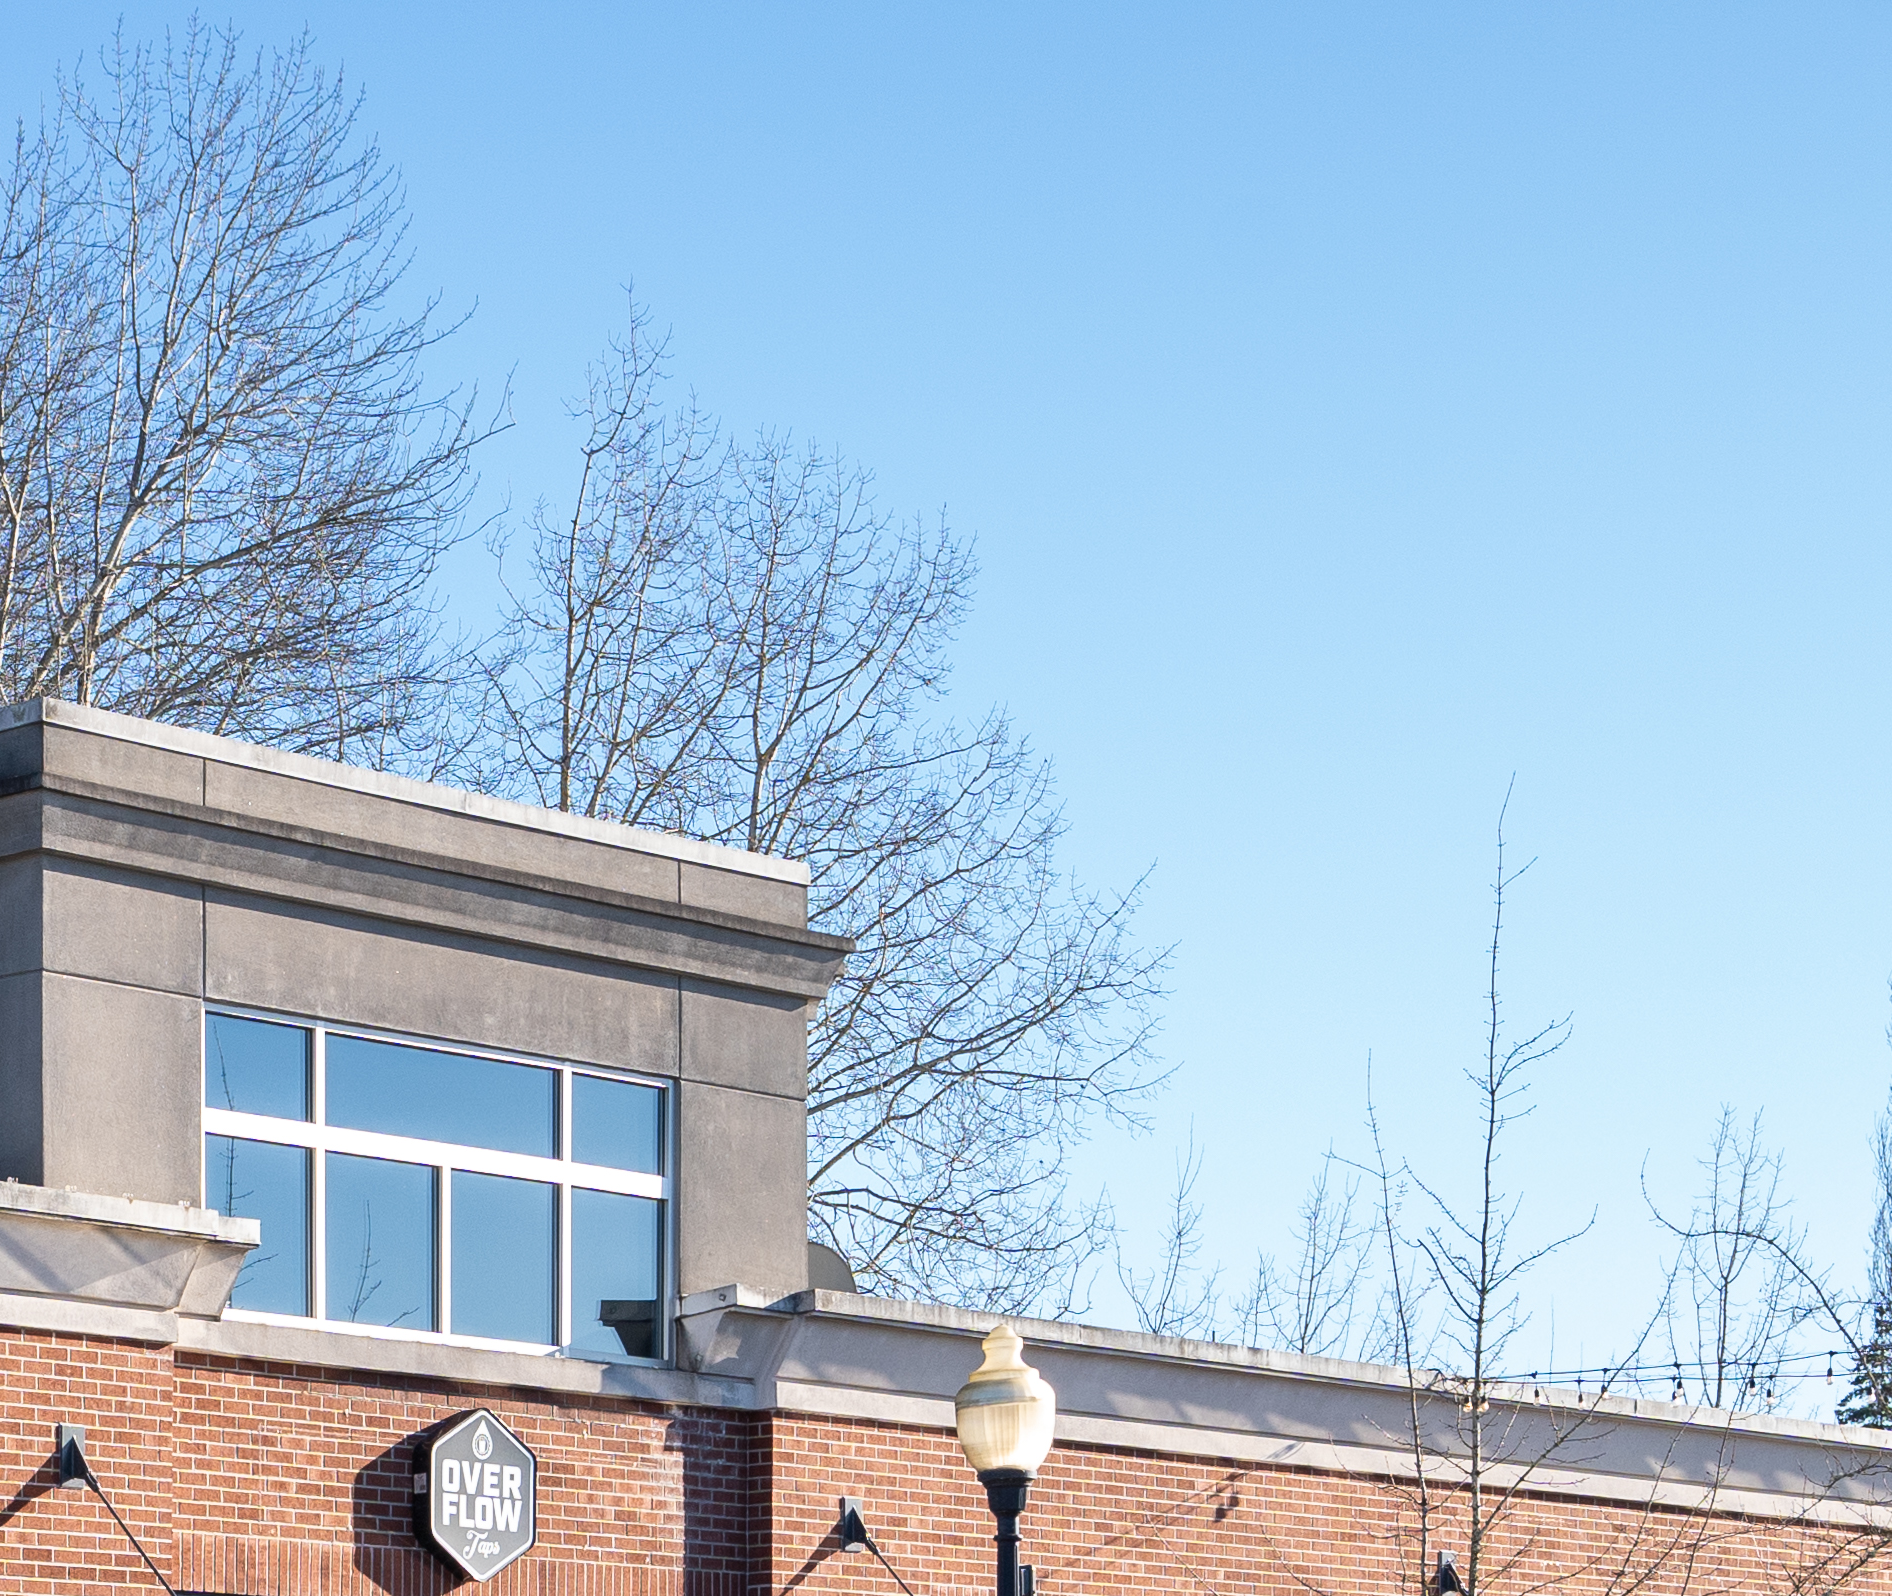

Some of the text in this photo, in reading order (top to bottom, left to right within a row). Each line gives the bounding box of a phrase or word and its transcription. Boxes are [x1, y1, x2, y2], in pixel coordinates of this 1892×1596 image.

[441, 1458, 522, 1500] OVER
[442, 1492, 523, 1533] FLOW
[462, 1529, 501, 1560] Taps
